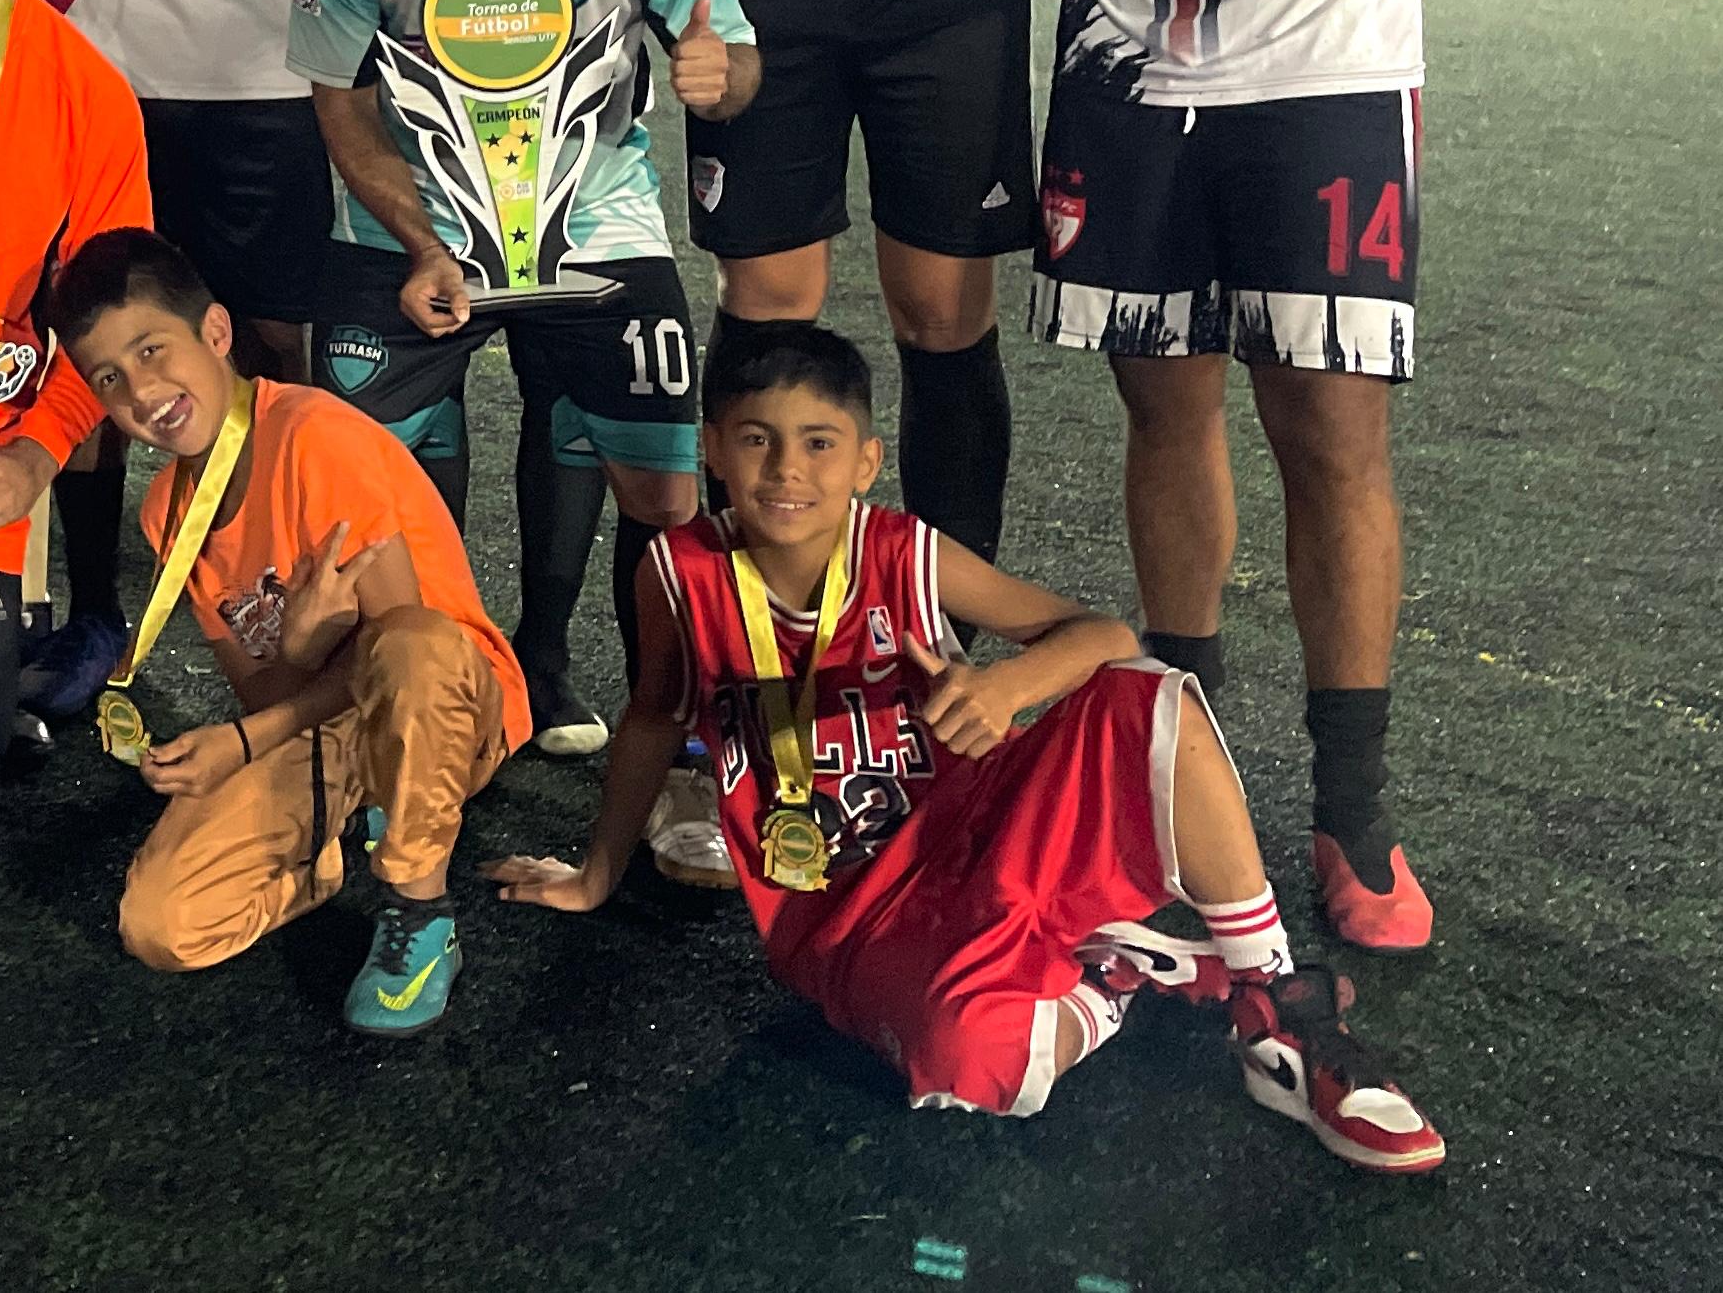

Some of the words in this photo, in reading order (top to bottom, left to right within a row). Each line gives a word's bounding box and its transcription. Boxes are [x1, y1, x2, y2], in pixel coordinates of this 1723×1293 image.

[467, 2, 518, 17] Torneo
[461, 13, 530, 36] Fútbol
[1317, 177, 1405, 282] 14
[329, 342, 382, 361] FUTRASH
[622, 318, 690, 396] 10
